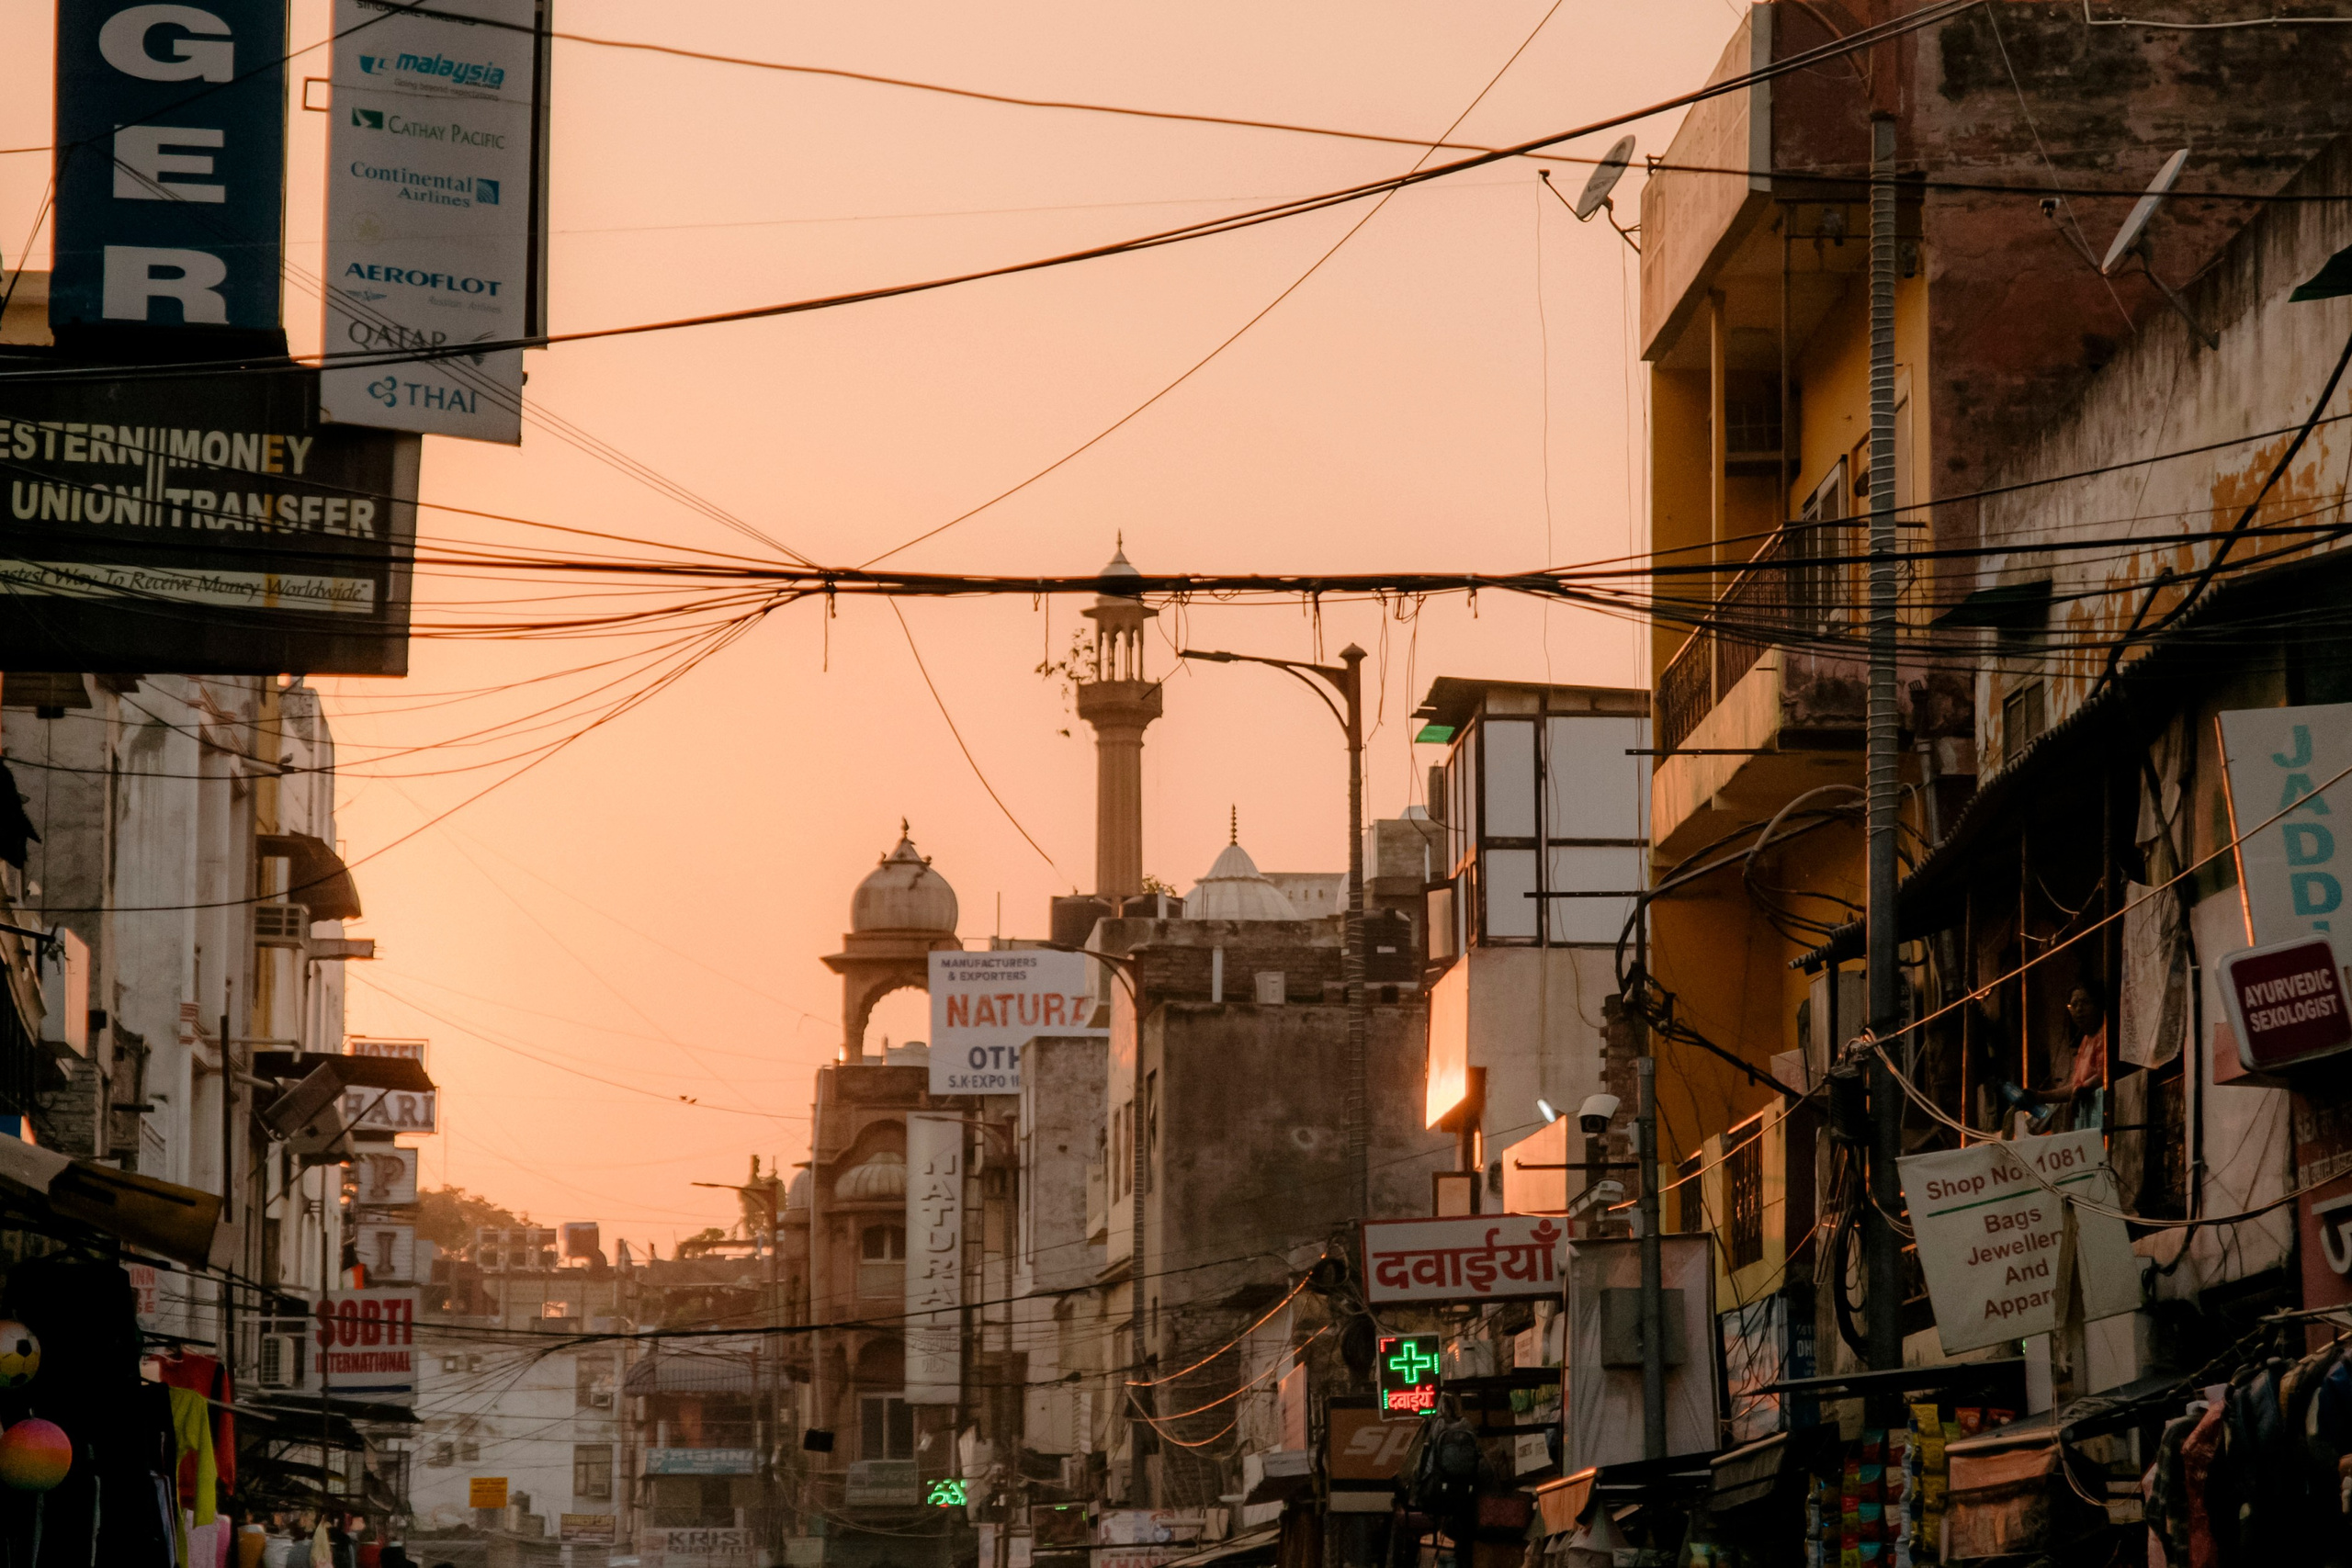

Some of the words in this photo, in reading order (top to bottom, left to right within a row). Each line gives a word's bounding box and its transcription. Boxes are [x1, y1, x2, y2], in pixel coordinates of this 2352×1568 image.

[396, 52, 504, 85] malaysia
[388, 115, 446, 141] CATHAY
[451, 124, 505, 150] PACIFIC
[98, 4, 235, 325] GER
[350, 161, 472, 193] Continental
[396, 186, 470, 208] Airlines
[345, 262, 502, 297] AEROFLOT
[403, 381, 476, 413] THAI
[168, 428, 313, 475] MONEY
[12, 479, 141, 525] UNION
[165, 488, 375, 538] TRANSFER
[104, 569, 124, 585] To
[130, 570, 189, 592] Receive
[198, 574, 261, 603] Money
[2270, 724, 2343, 931] JADD
[941, 957, 1037, 968] MANUFACTURERS
[948, 972, 956, 981] &
[959, 971, 1026, 981] EXPORTERS
[2245, 968, 2334, 1009] AYURVEDIC
[2249, 994, 2338, 1032] SEXOLOGIST
[345, 1093, 435, 1127] HARI
[1926, 1176, 1986, 1201] Shop
[2035, 1145, 2086, 1173] 1081
[1984, 1208, 2042, 1234] Bags
[1967, 1230, 2063, 1266] Jeweller
[2005, 1257, 2050, 1286] And
[1984, 1289, 2055, 1319] Appar
[315, 1298, 413, 1348] SOBTI
[315, 1351, 412, 1373] ITERNATIONAL
